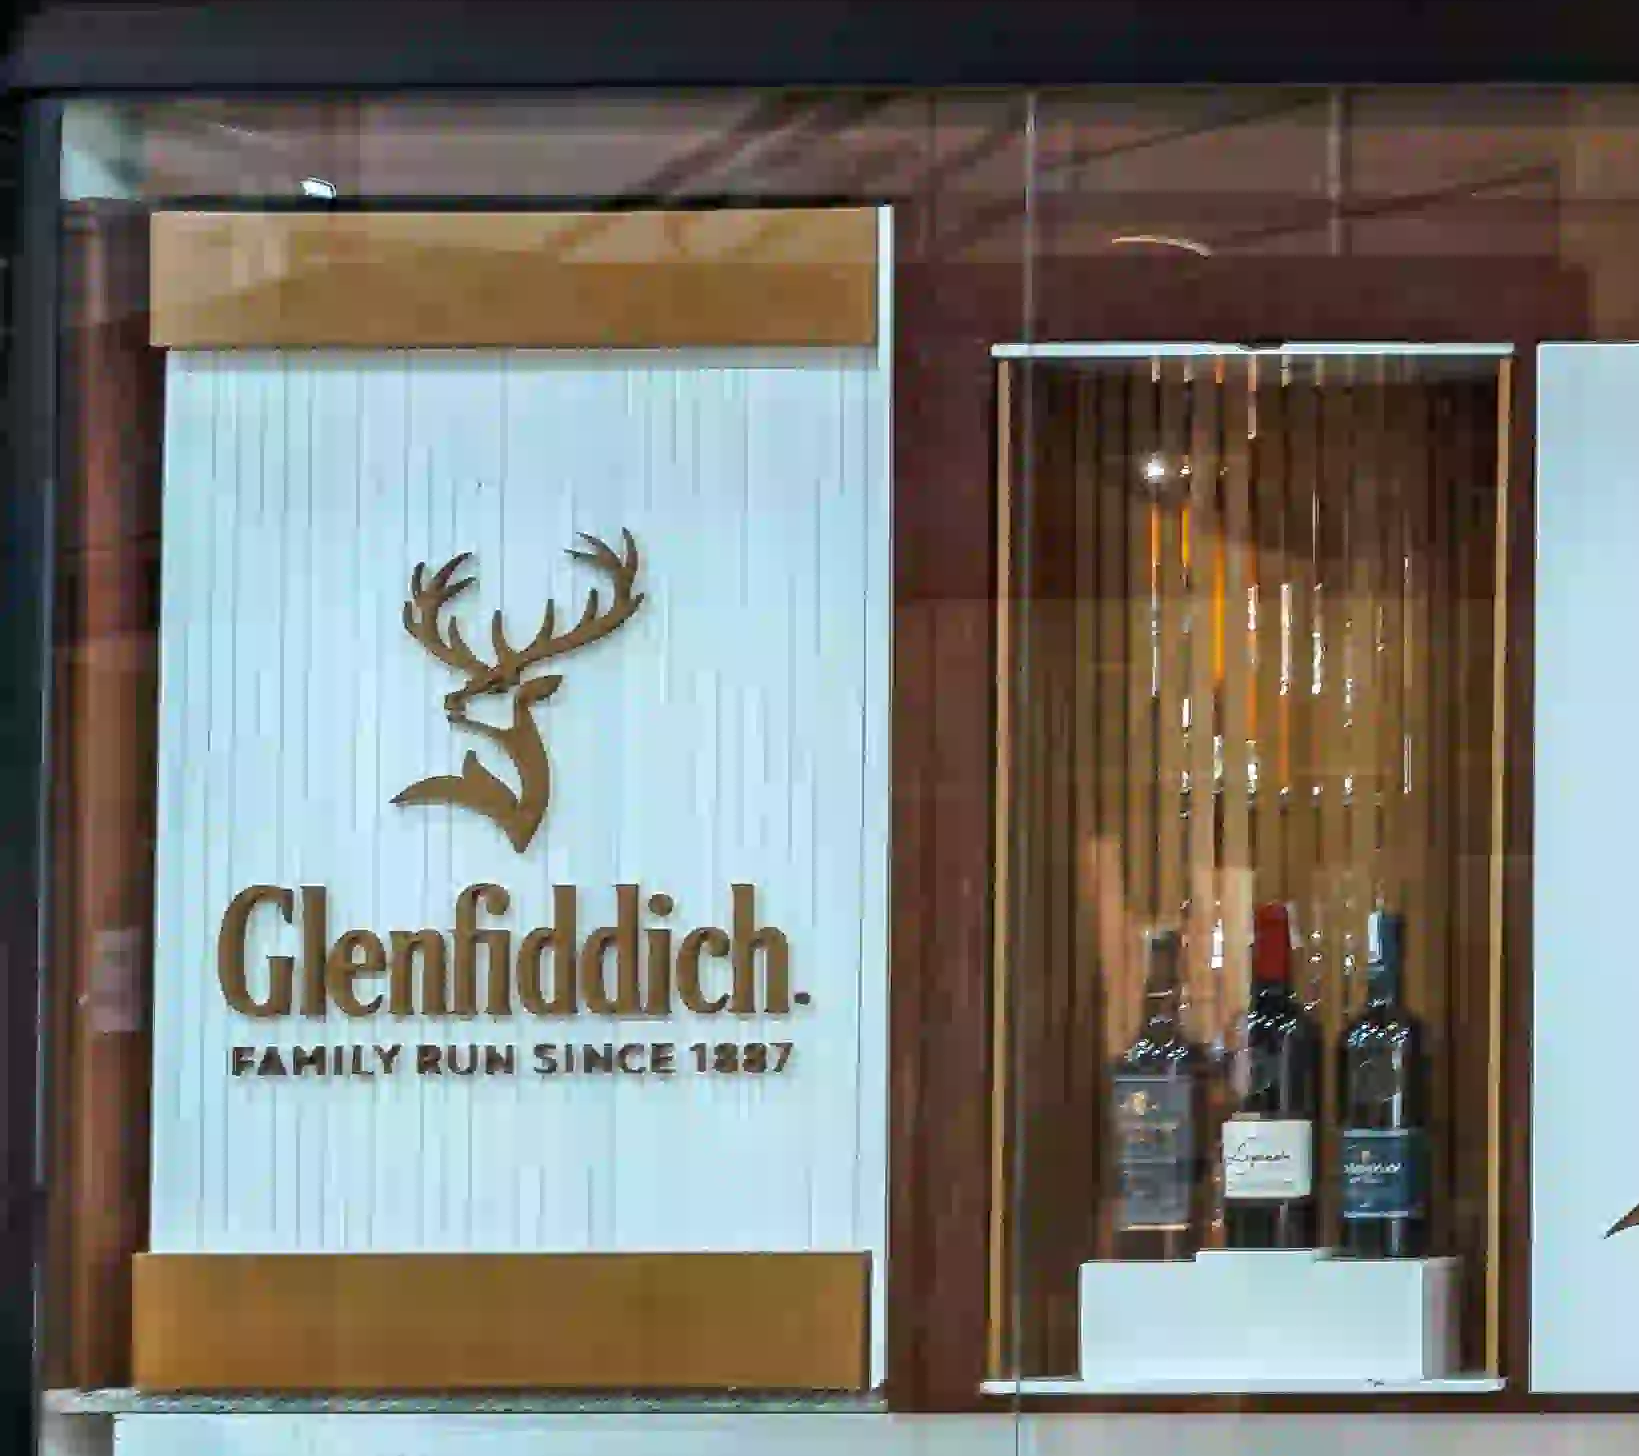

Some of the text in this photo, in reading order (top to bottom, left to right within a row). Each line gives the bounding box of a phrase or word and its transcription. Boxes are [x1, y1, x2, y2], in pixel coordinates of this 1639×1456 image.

[230, 1040, 794, 1078] FAMILY RUN SINCE 1887
